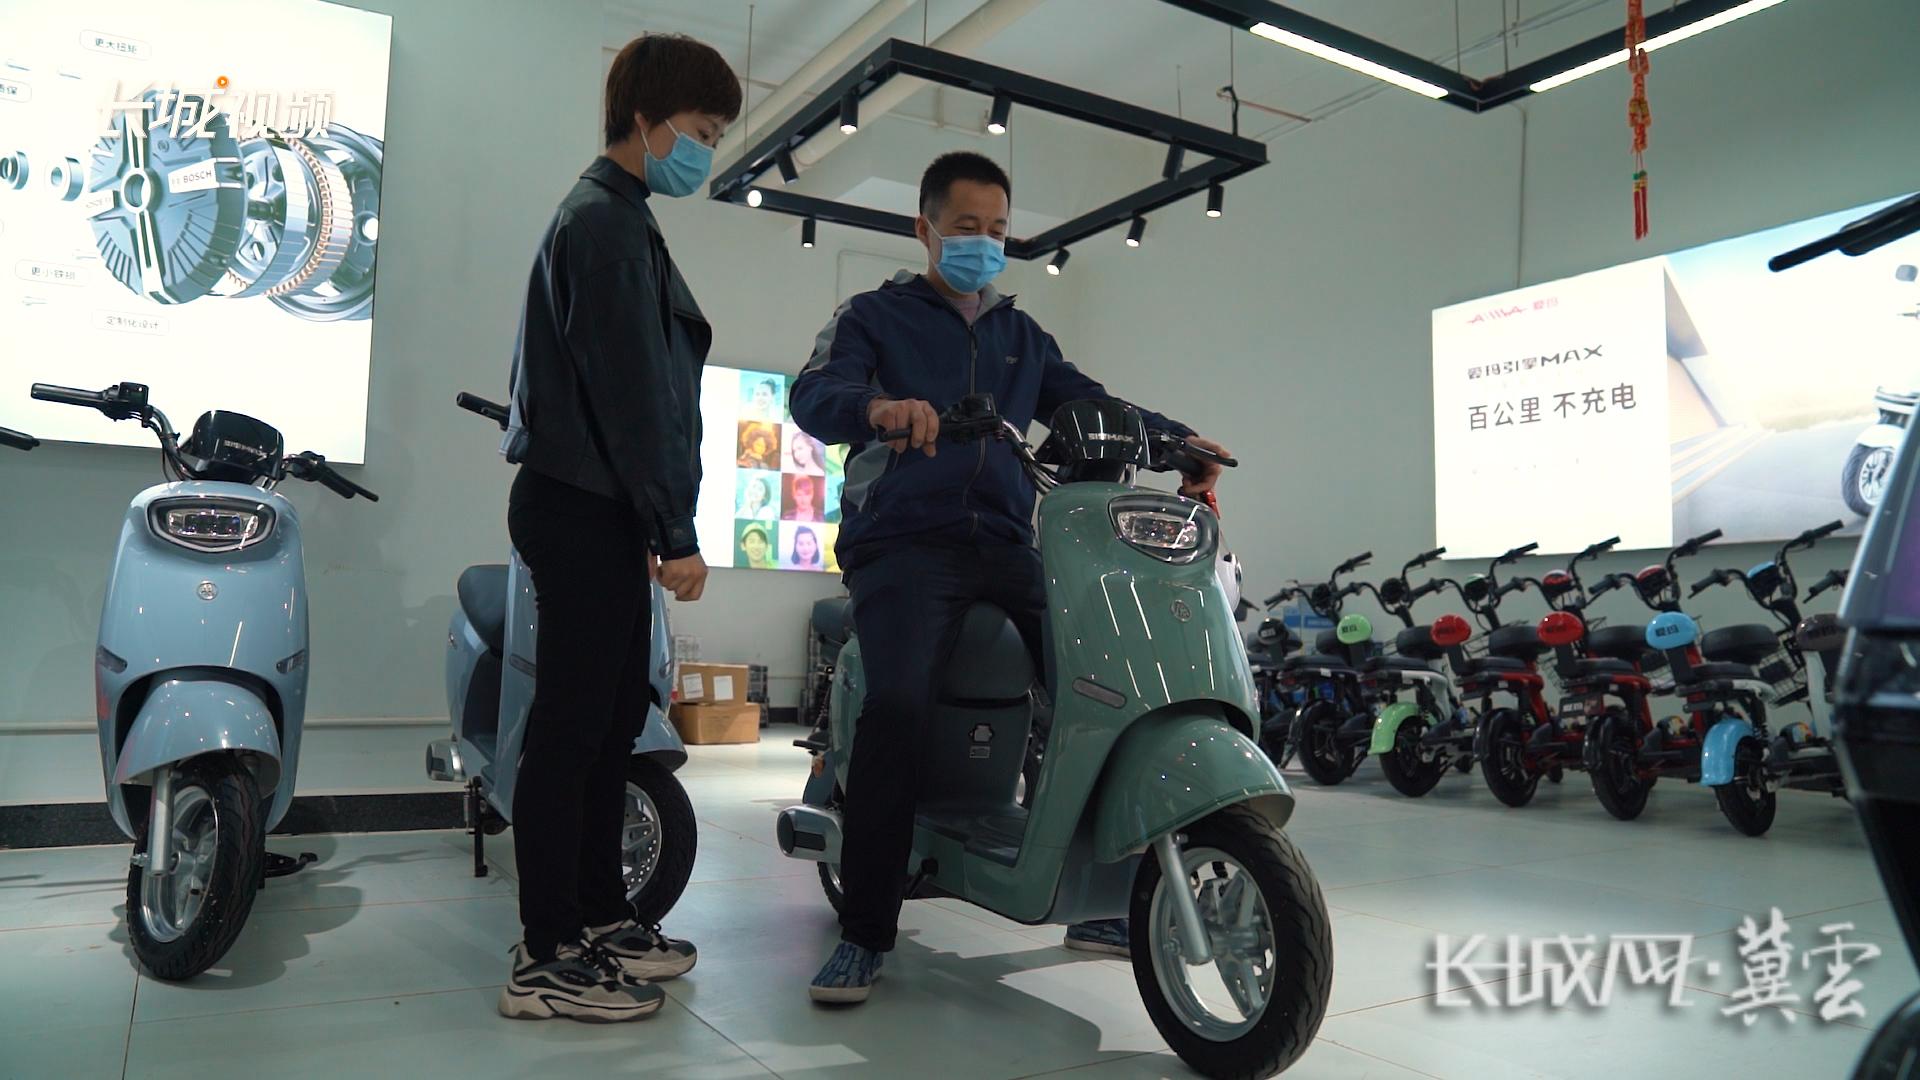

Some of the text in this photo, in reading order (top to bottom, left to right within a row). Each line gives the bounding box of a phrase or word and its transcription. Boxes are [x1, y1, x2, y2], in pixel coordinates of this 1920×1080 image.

[183, 169, 213, 184] BOSCH
[1467, 382, 1637, 431] 百公里 不充电
